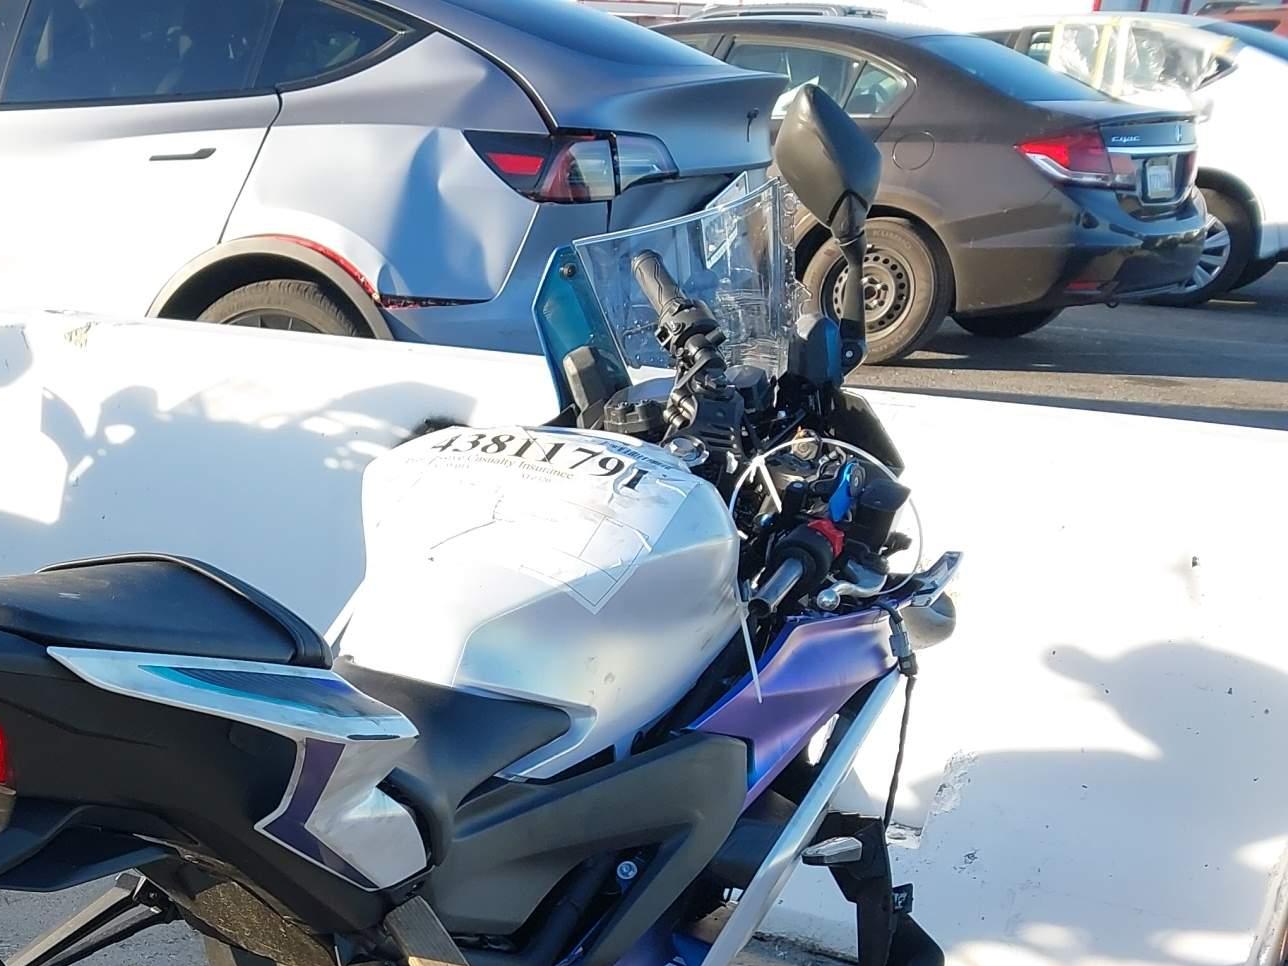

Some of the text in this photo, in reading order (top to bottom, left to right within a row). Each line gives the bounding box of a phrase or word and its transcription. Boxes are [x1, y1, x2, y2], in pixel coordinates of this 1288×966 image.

[431, 432, 650, 491] 43811791
[468, 453, 515, 470] Casualty
[517, 459, 575, 481] Insurance
